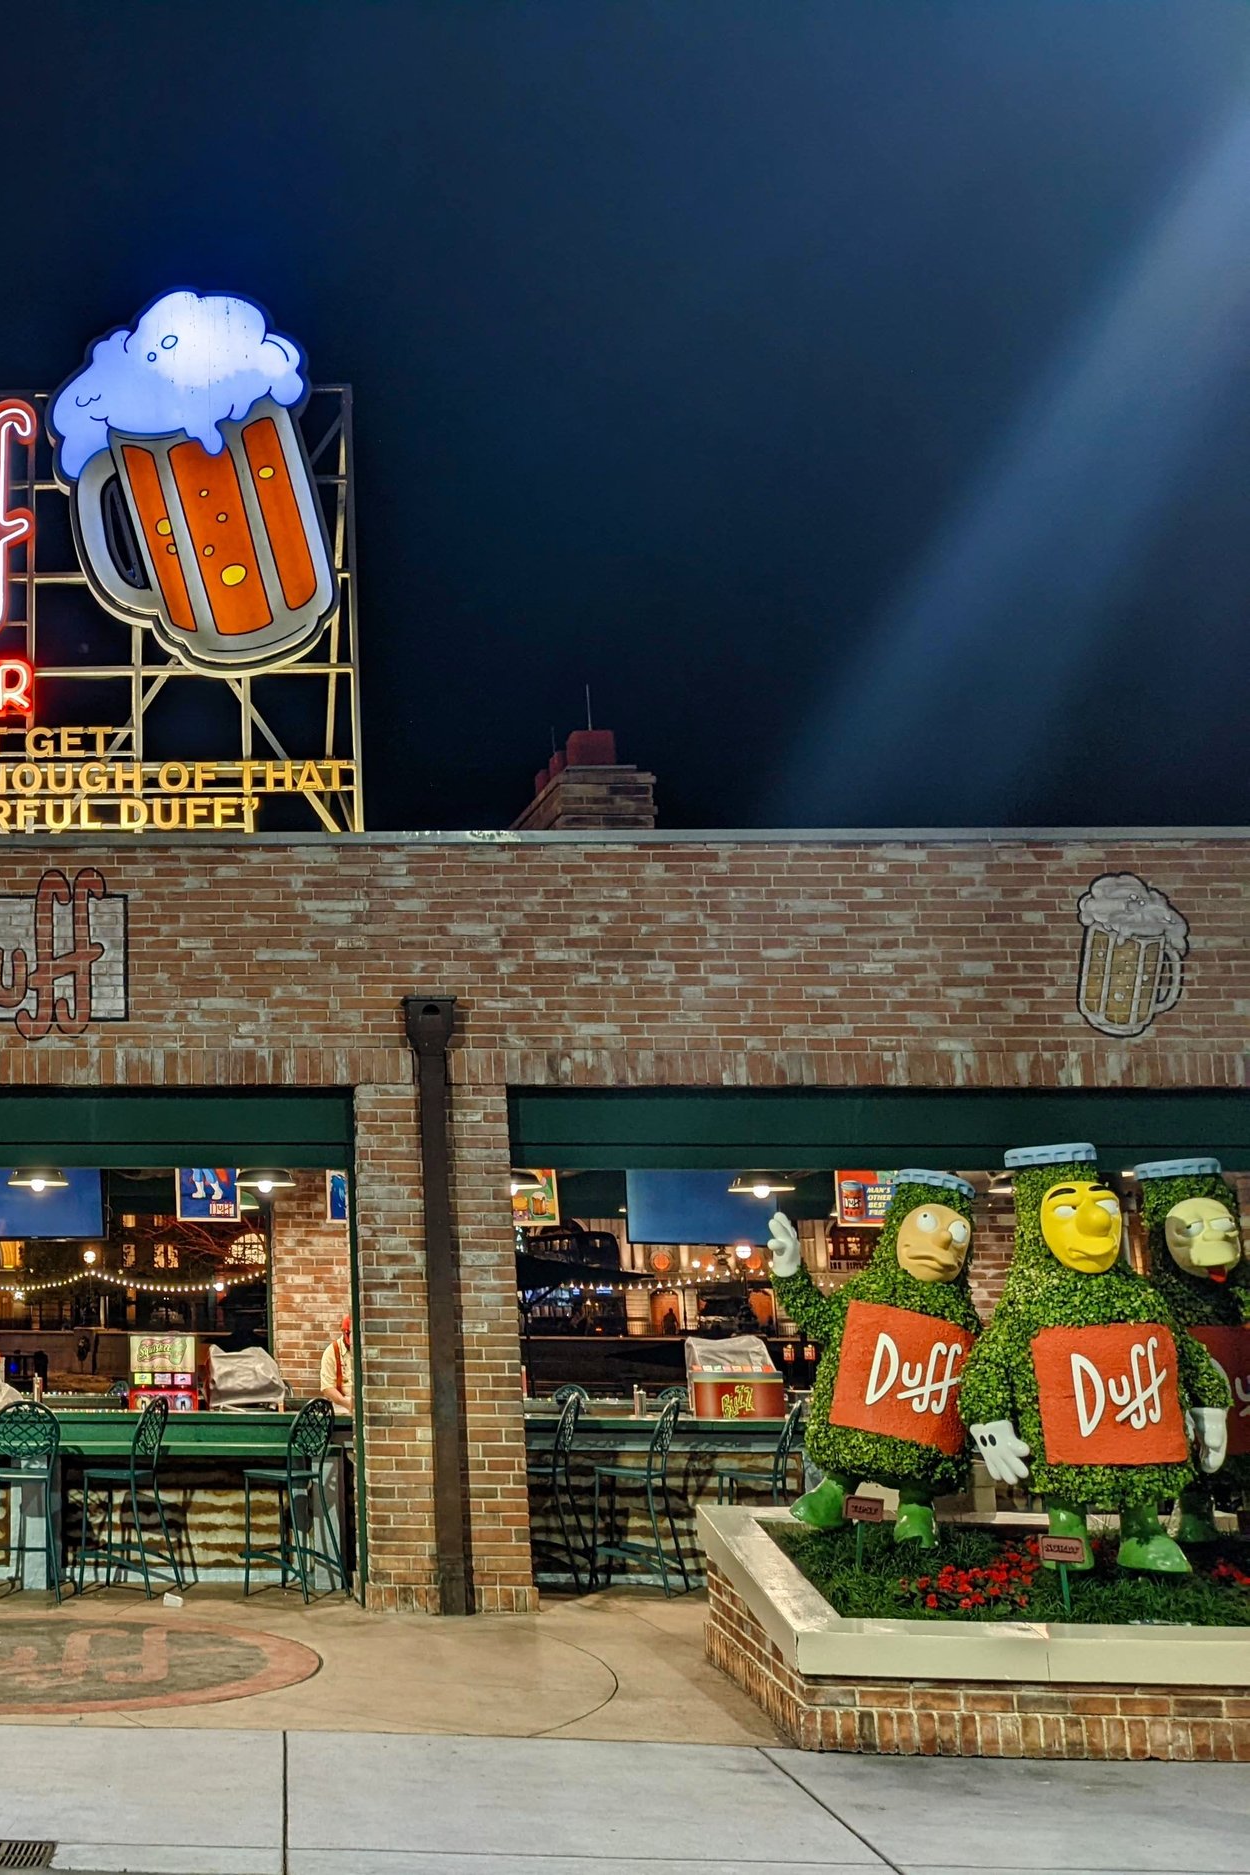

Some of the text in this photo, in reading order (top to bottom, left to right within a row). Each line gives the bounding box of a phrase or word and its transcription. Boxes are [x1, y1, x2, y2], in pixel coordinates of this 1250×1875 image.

[25, 726, 113, 758] GET
[158, 761, 218, 792] OF
[235, 760, 348, 791] THAT
[119, 797, 259, 830] DUFF"
[866, 1186, 891, 1194] MAN'S
[867, 1201, 887, 1209] BEST
[864, 1332, 962, 1415] Duff
[1069, 1336, 1167, 1438] Duff
